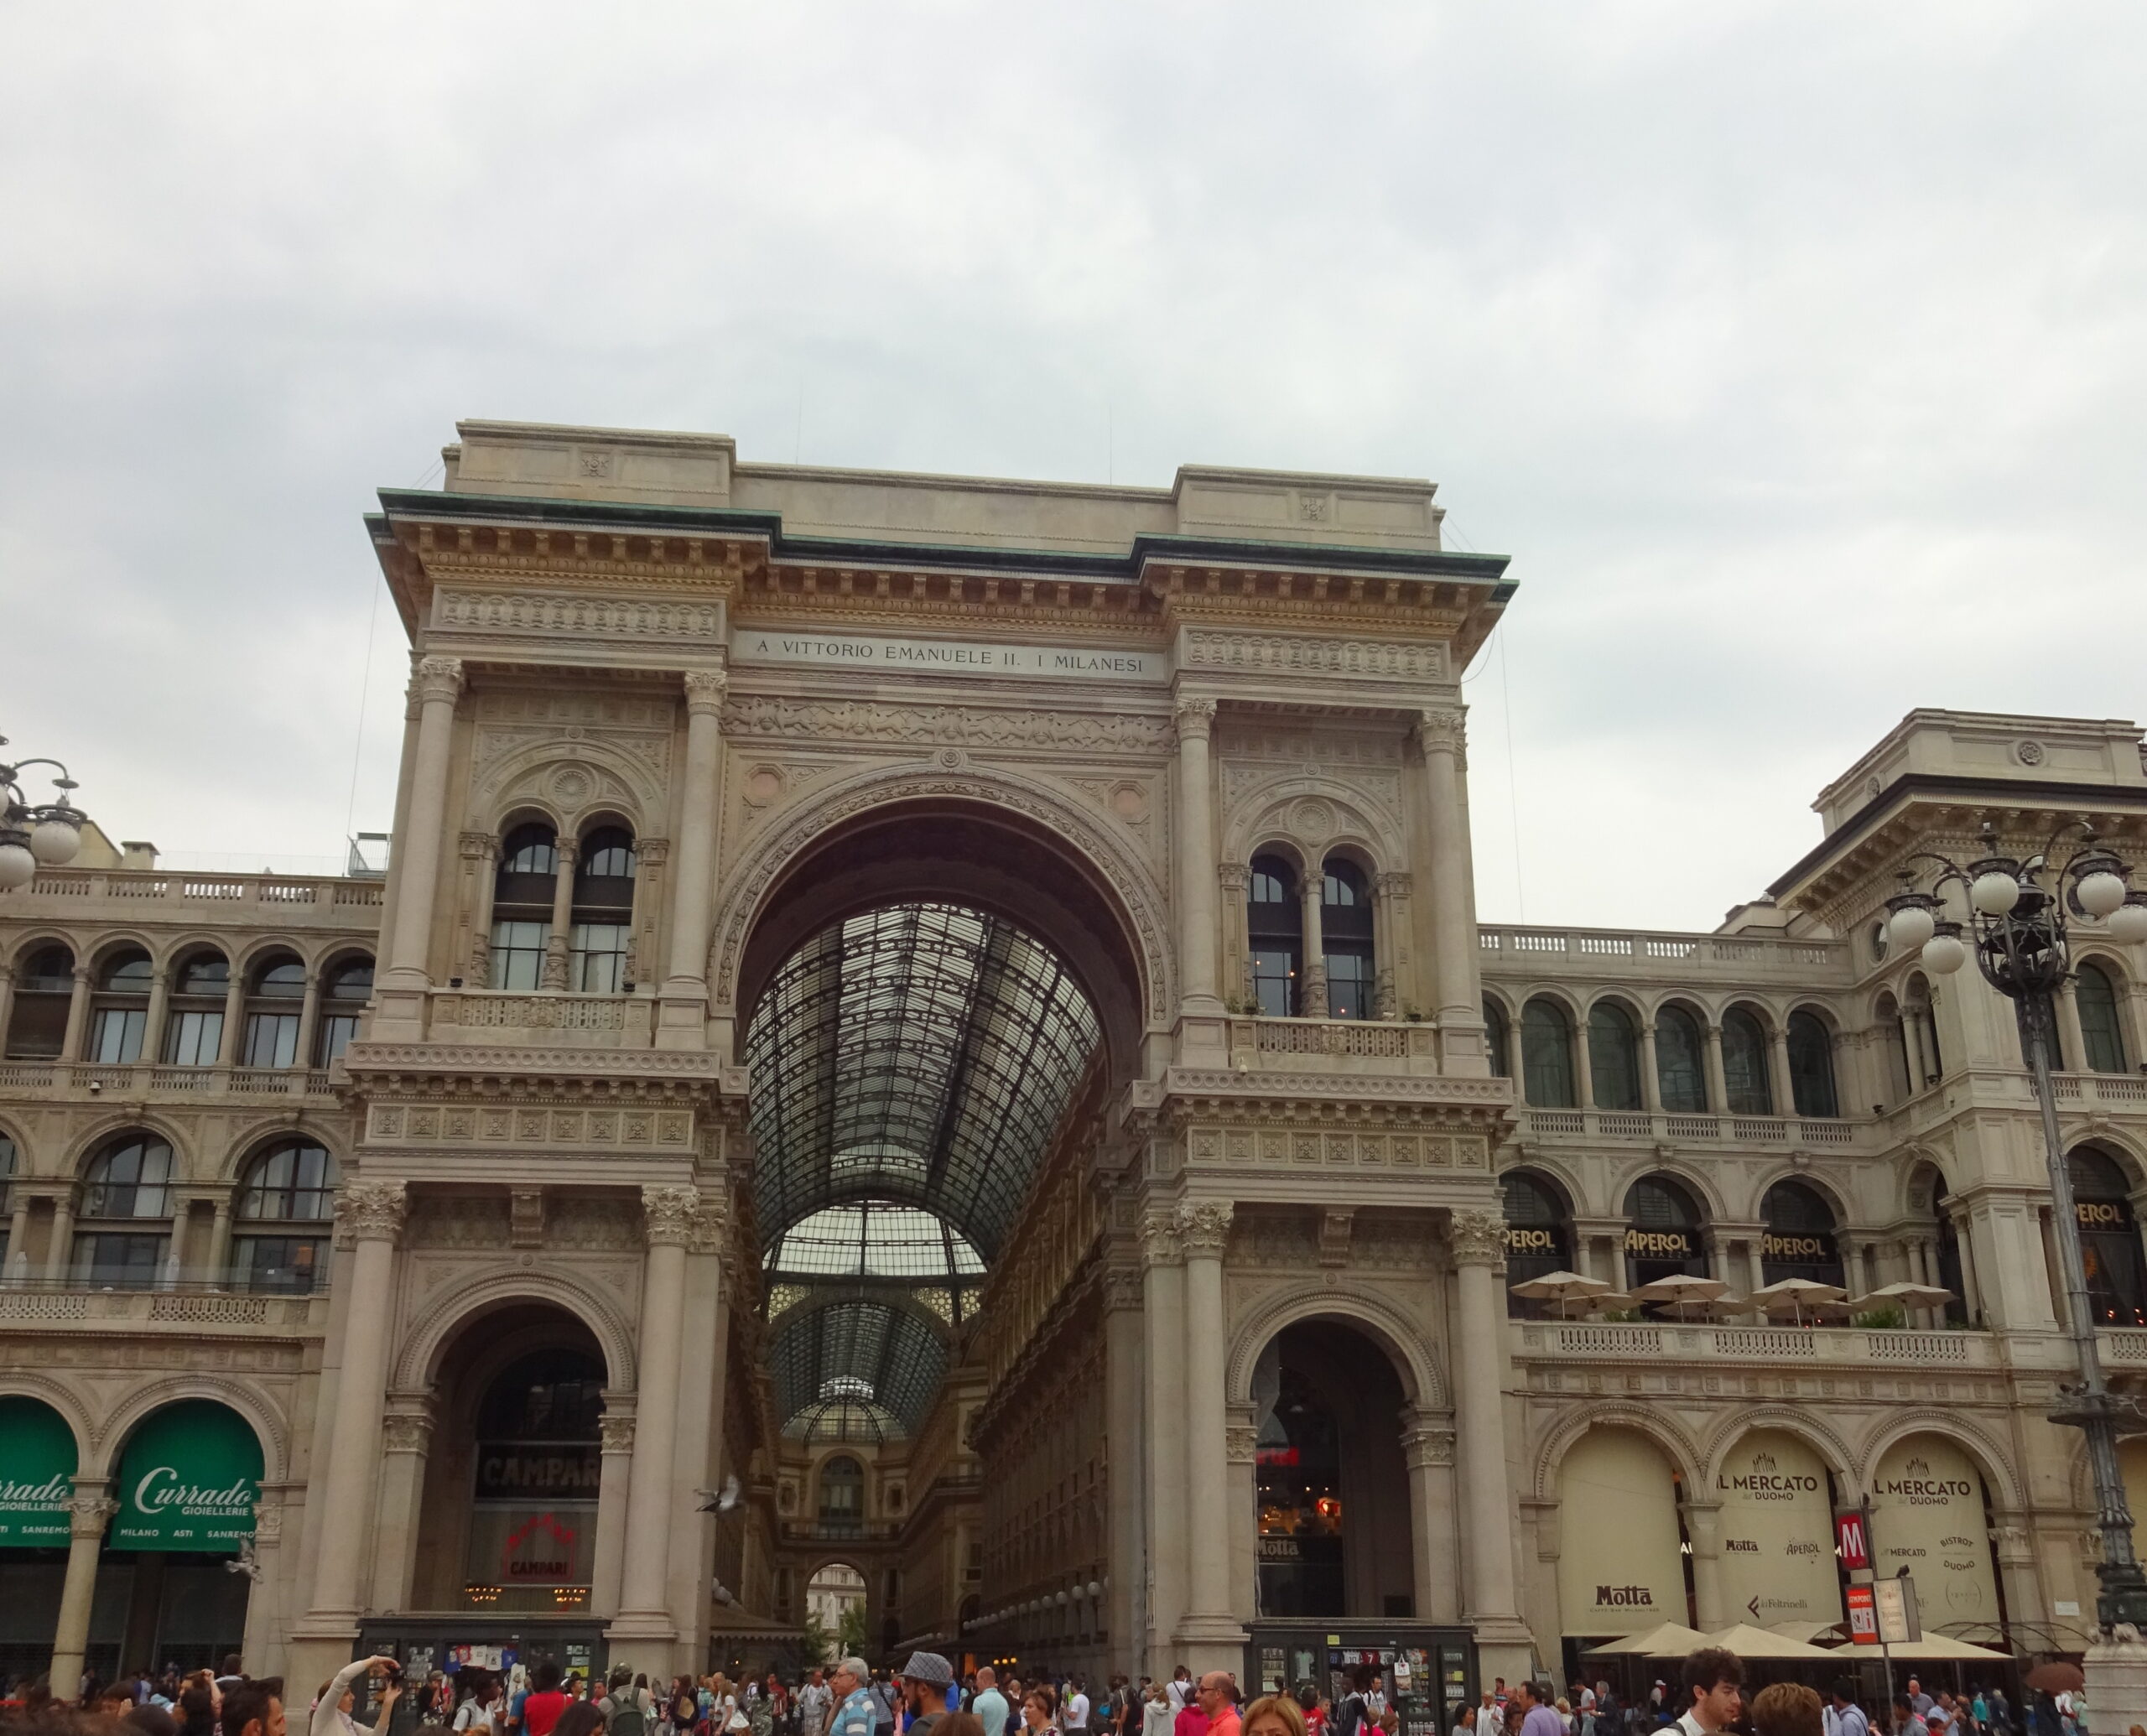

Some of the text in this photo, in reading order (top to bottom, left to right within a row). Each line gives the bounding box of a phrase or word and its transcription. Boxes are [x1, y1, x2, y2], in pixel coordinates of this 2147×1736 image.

[757, 640, 769, 652] A
[782, 641, 873, 658] VITTORIO
[885, 646, 992, 664] EMANUELE
[1037, 655, 1042, 667] I
[1054, 656, 1142, 672] MILANESI
[1625, 1229, 1692, 1251] APEROL
[1761, 1233, 1826, 1255] APEROL
[1733, 1475, 1818, 1491] MERCATO
[1887, 1480, 1971, 1496] MERCATO
[134, 1467, 252, 1514] Currado
[1755, 1492, 1794, 1500] DUOMO
[1910, 1496, 1948, 1505] DUOMO
[181, 1506, 249, 1516] GIOIELLERIE
[21, 1525, 70, 1534] SANREMO
[120, 1528, 159, 1537] MILANO
[207, 1531, 255, 1539] SANREMO
[1726, 1539, 1759, 1551] Motta
[1842, 1522, 1864, 1557] M
[1940, 1536, 1973, 1547] BISTROT
[1257, 1539, 1300, 1556] Motta
[1786, 1543, 1821, 1556] APEROL
[1890, 1548, 1926, 1557] MERCATO
[510, 1562, 568, 1576] CAMPARI
[1943, 1560, 1975, 1571] DUOMO
[1596, 1585, 1653, 1605] Motta
[1367, 1654, 1374, 1664] 7
